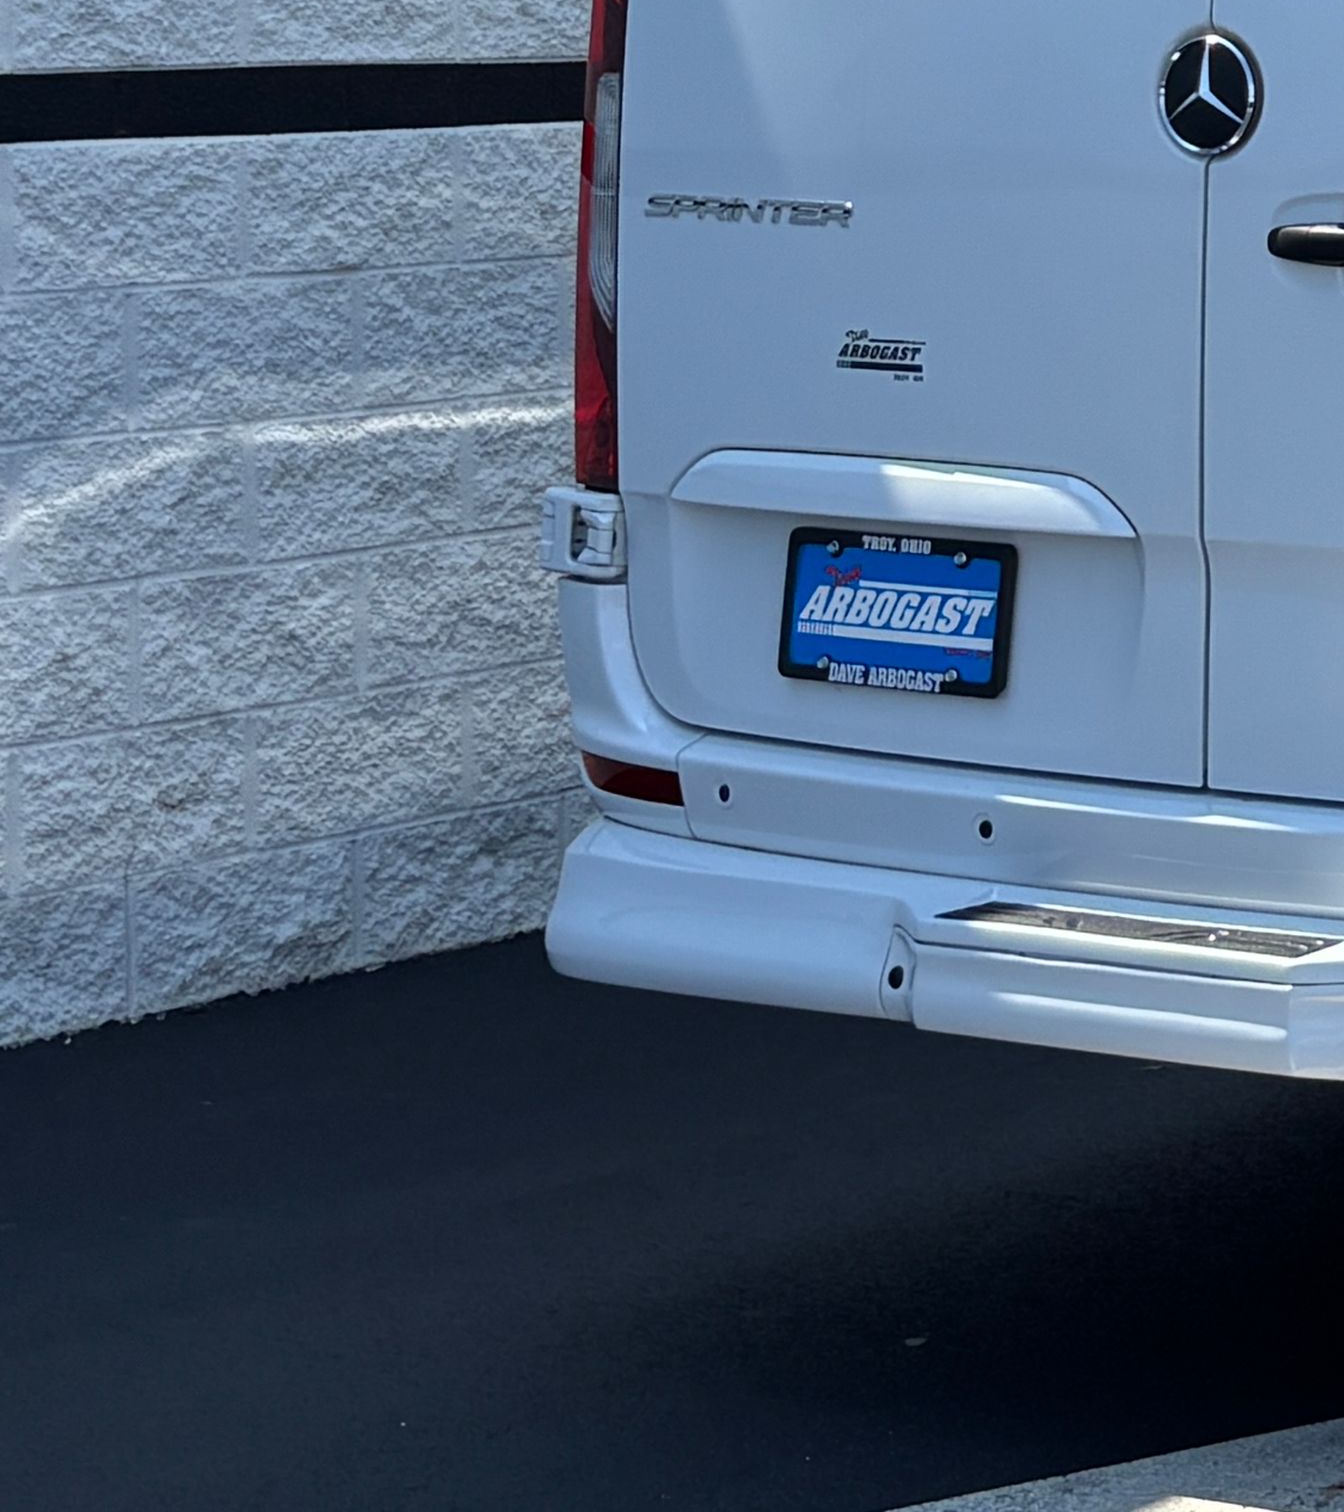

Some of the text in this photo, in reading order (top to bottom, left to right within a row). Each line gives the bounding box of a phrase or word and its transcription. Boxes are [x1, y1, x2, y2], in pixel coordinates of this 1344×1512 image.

[644, 193, 854, 228] SPRINTER
[838, 343, 922, 361] ARBOGAST
[901, 538, 932, 555] OHIO
[800, 585, 995, 635] ARBOGAST
[828, 662, 944, 693] DAVE ARBOGAST
